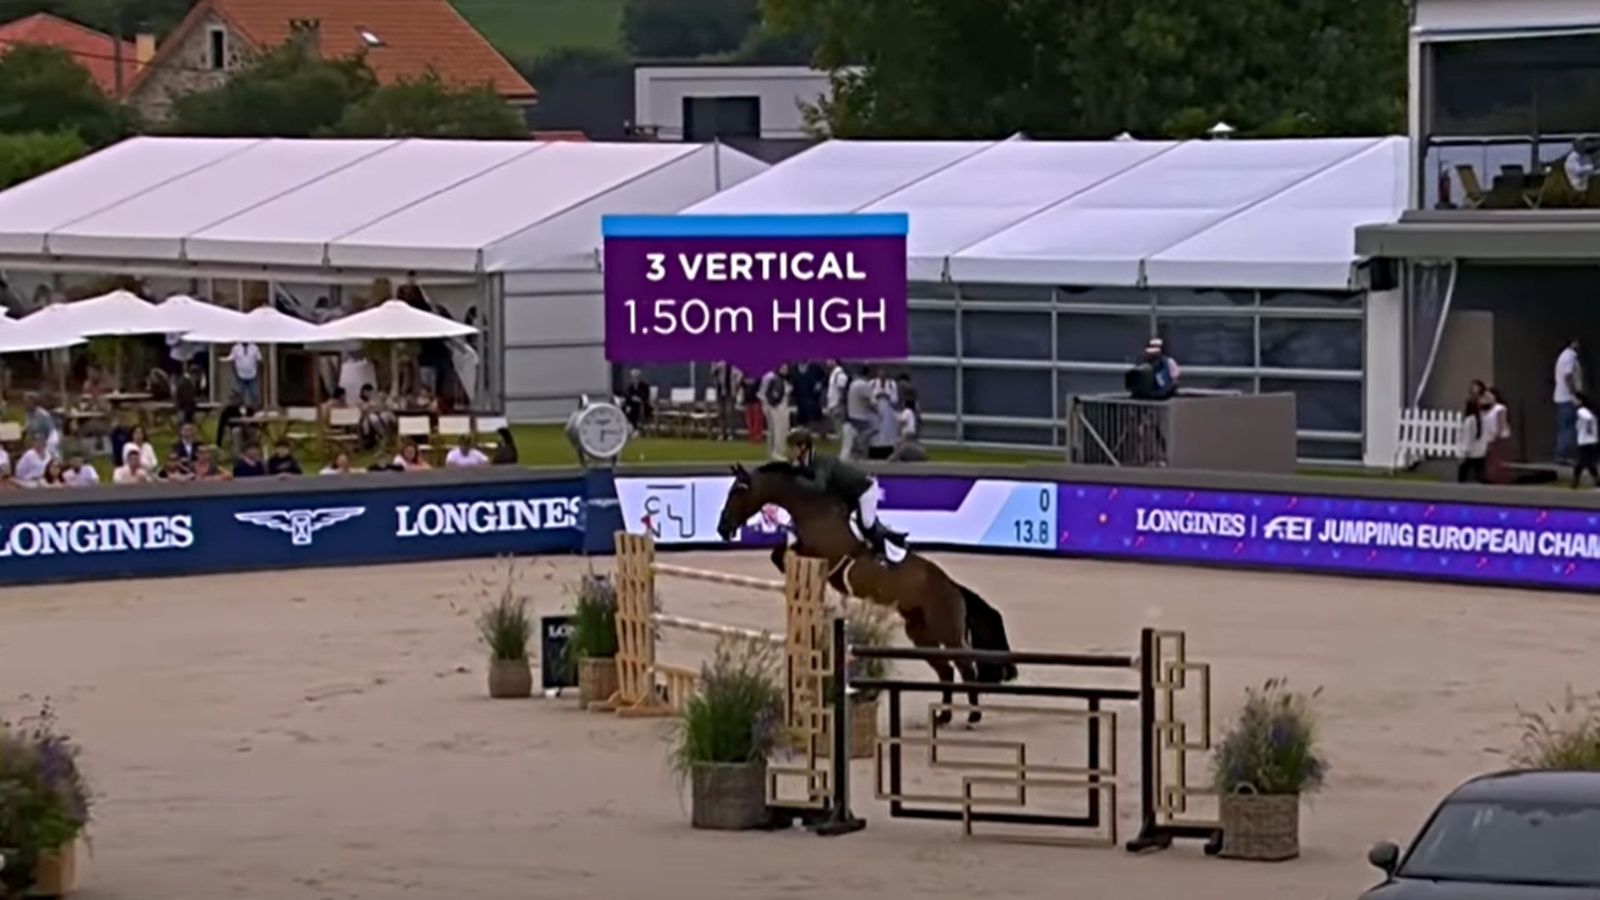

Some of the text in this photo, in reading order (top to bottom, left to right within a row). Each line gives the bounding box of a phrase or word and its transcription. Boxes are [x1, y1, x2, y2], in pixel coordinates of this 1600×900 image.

[1040, 488, 1050, 512] 0
[1014, 519, 1049, 544] 13.8
[1136, 508, 1246, 537] LONGINES
[1318, 519, 1415, 547] JUMPING
[1417, 524, 1535, 555] EUROPEAN
